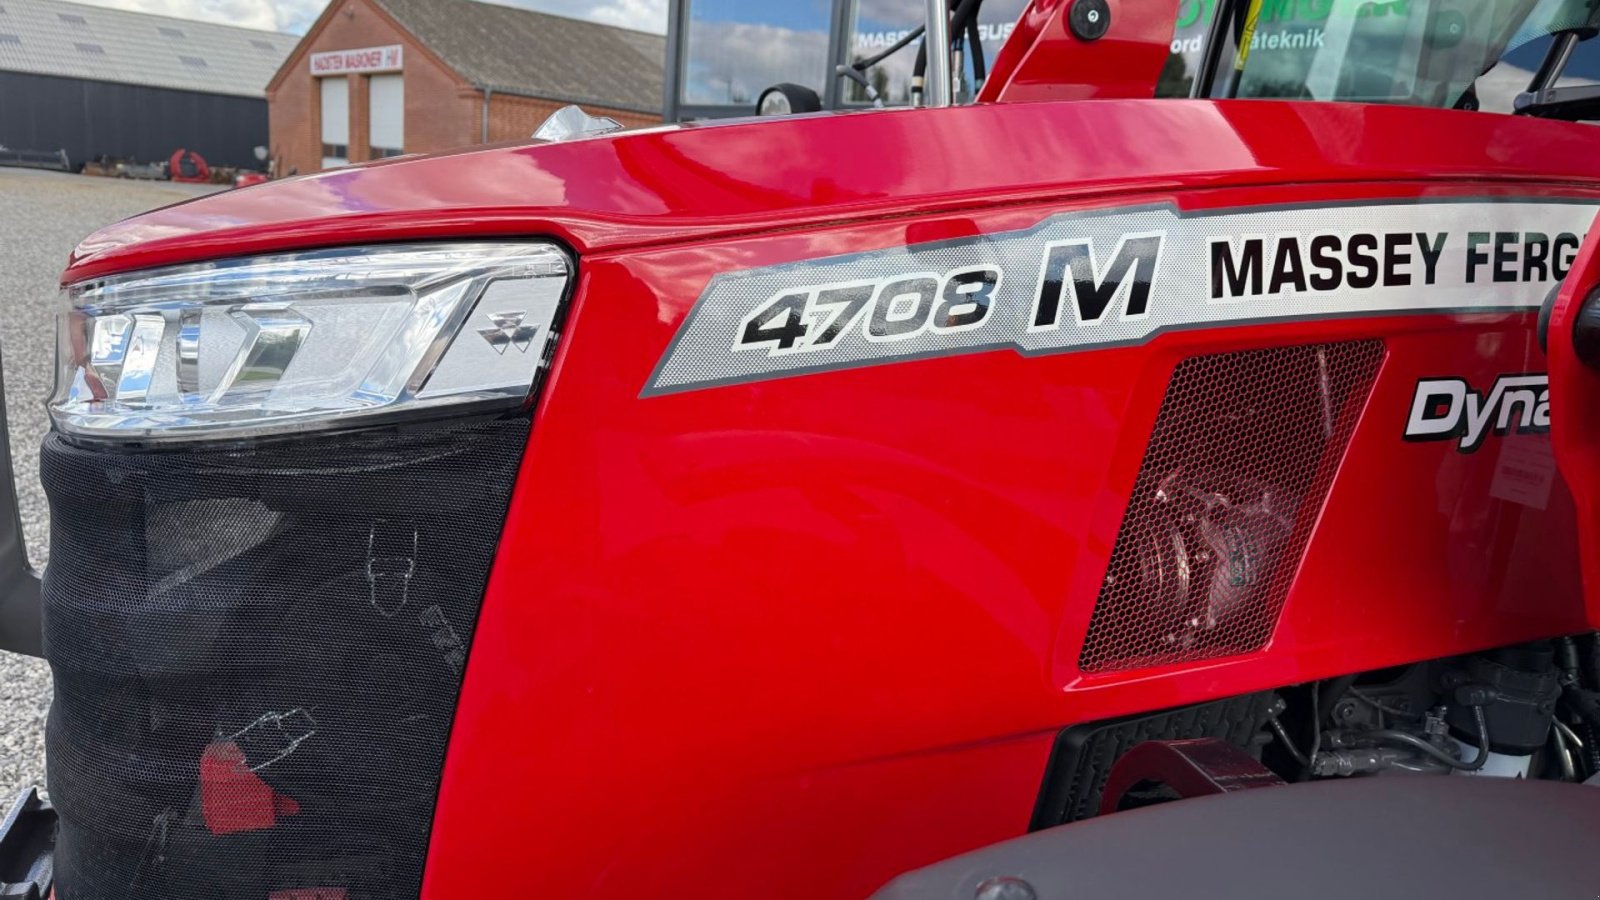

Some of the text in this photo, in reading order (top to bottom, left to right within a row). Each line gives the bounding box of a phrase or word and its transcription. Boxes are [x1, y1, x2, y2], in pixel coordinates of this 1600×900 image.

[1249, 29, 1325, 49] åteknik
[736, 232, 1165, 354] 4708 M
[1210, 232, 1585, 299] MASSEY FERG
